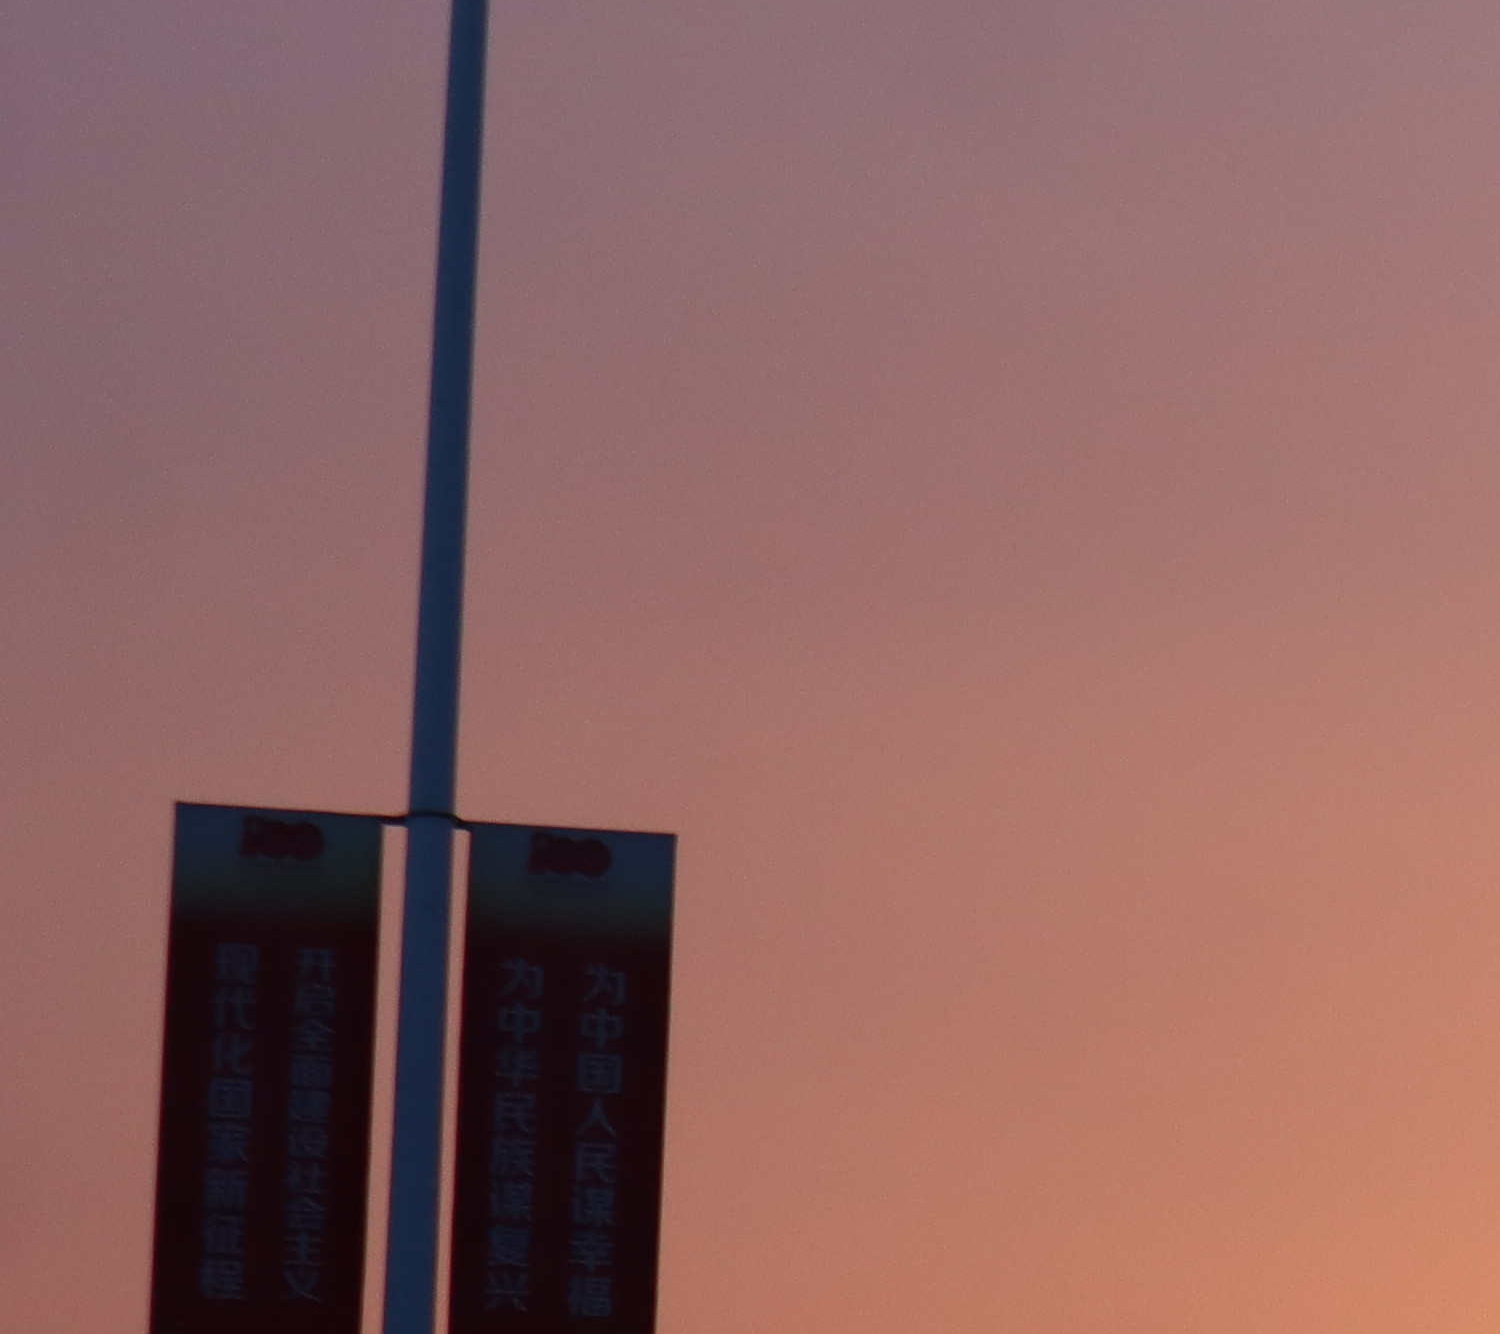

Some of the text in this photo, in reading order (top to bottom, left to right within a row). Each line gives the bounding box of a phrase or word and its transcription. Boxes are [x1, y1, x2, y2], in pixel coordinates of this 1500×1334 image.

[197, 942, 260, 1303] 现代化国家新征程
[279, 945, 339, 1304] 开启全面建设社会主义
[482, 955, 546, 1314] 为中华民族谋复兴
[566, 962, 627, 1319] 为中国人民谋幸福
